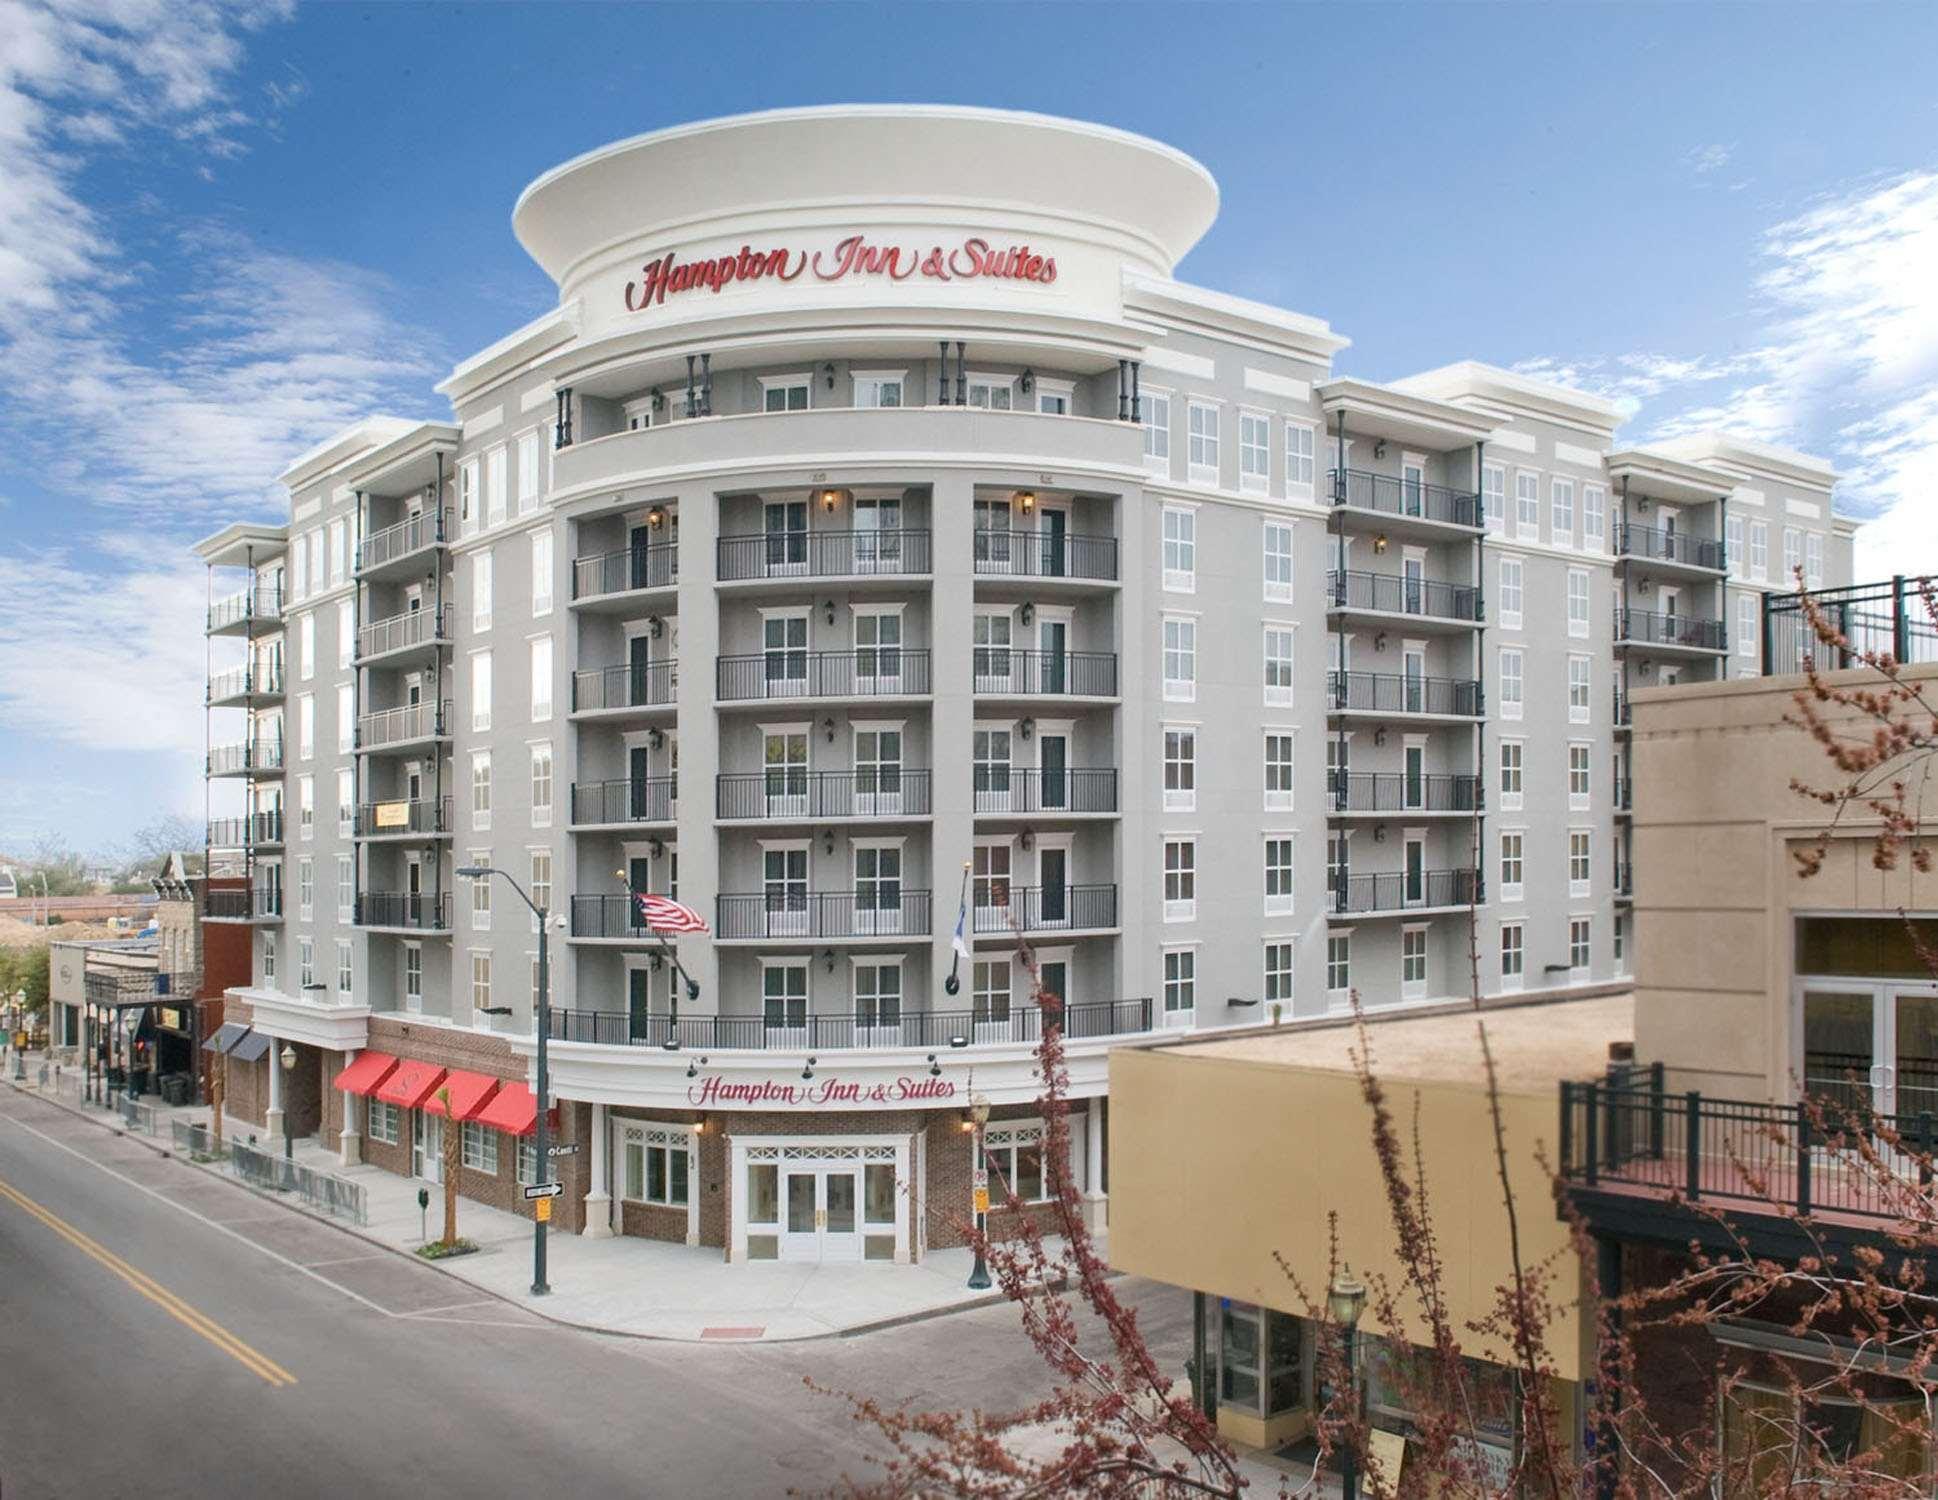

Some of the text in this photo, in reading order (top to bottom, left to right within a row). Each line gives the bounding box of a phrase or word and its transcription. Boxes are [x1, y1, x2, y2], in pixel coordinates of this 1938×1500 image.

[625, 235, 1057, 312] Hampton Inn & Suites
[687, 1076, 956, 1105] Hampton Inn & Suites
